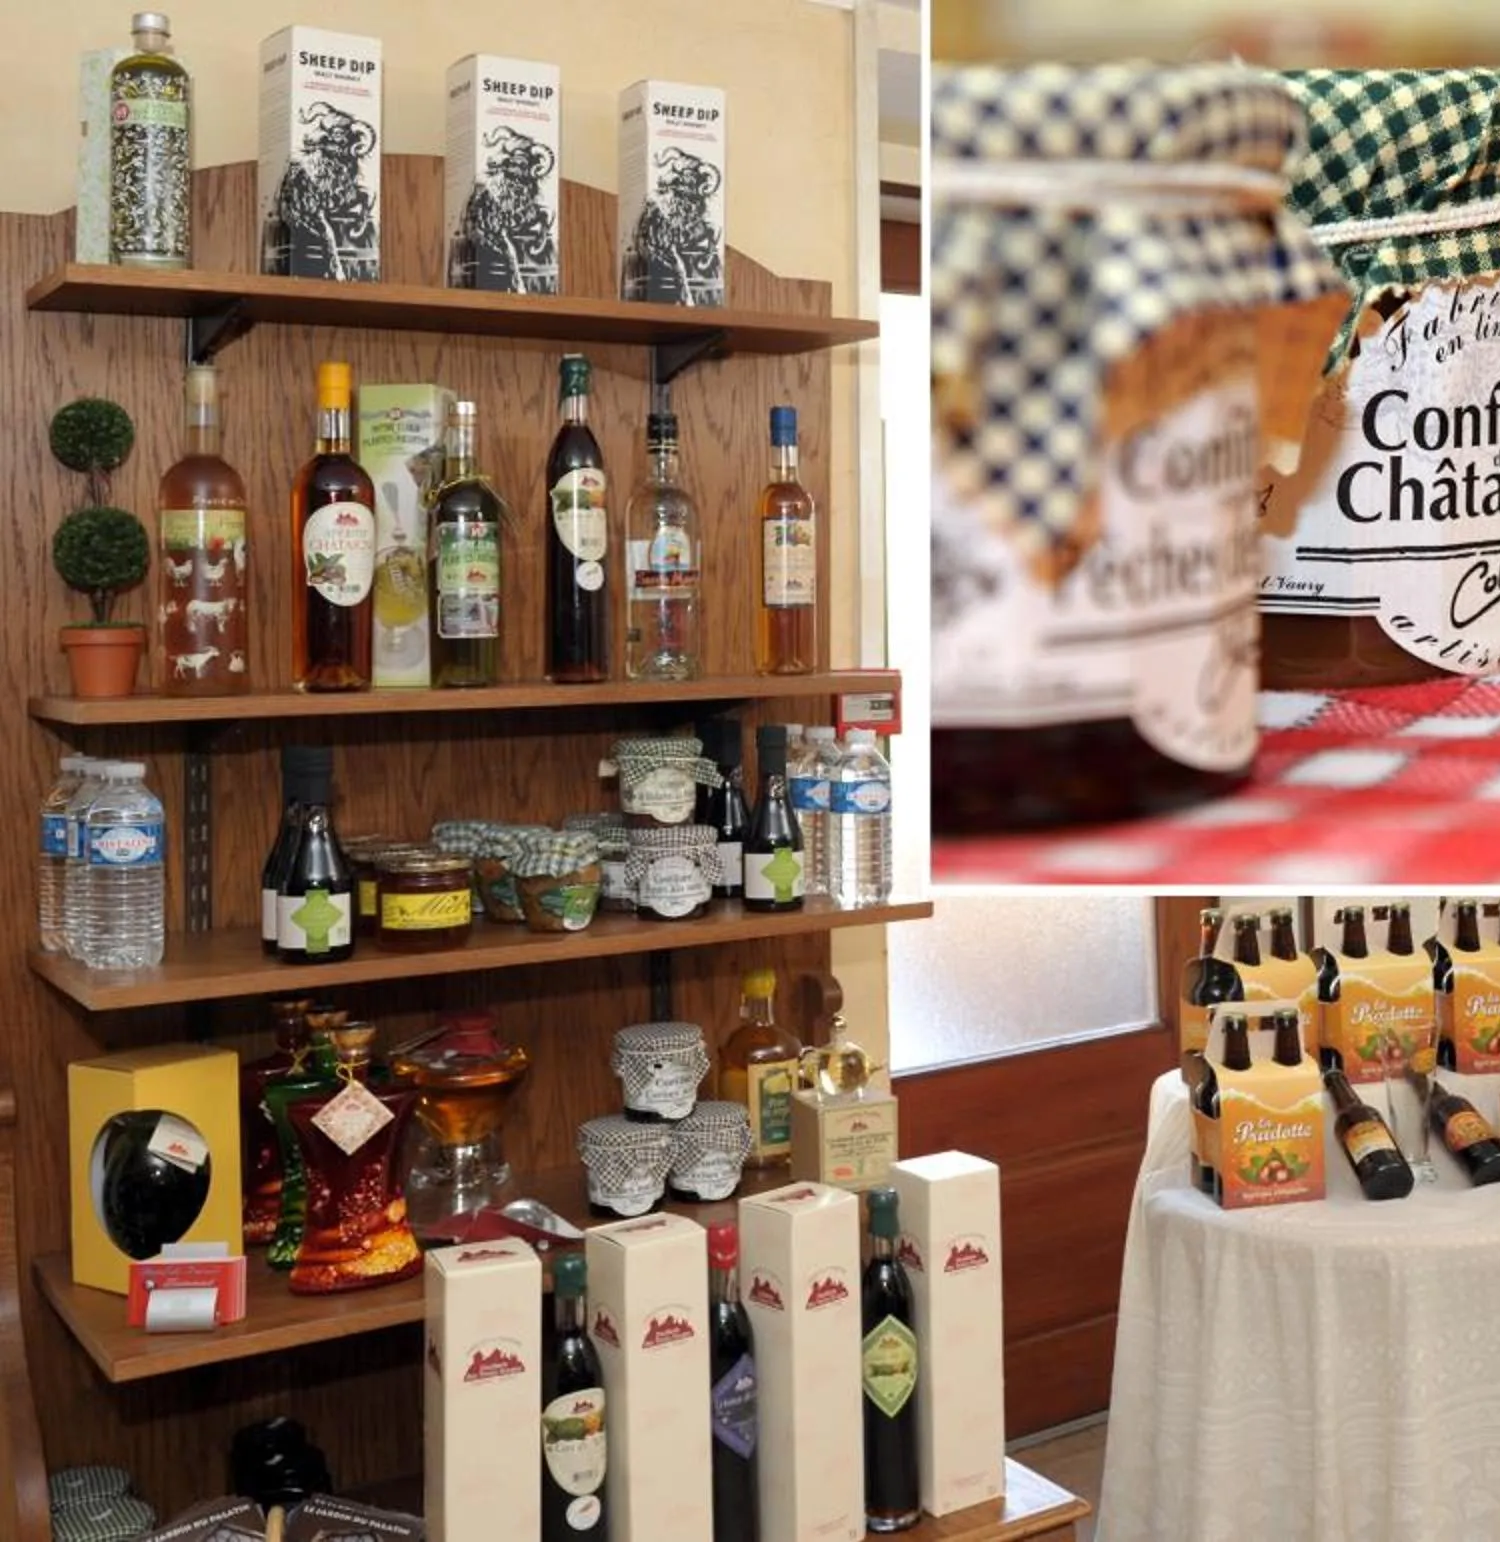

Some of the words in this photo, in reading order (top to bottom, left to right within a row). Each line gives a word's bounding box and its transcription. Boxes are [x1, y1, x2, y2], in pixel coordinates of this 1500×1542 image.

[299, 51, 346, 70] SHEEP
[350, 59, 376, 75] DIP
[483, 77, 527, 97] SHEEP
[530, 85, 554, 100] DIP
[653, 101, 695, 119] SHEEP
[697, 107, 720, 122] DIP
[1435, 335, 1465, 364] en
